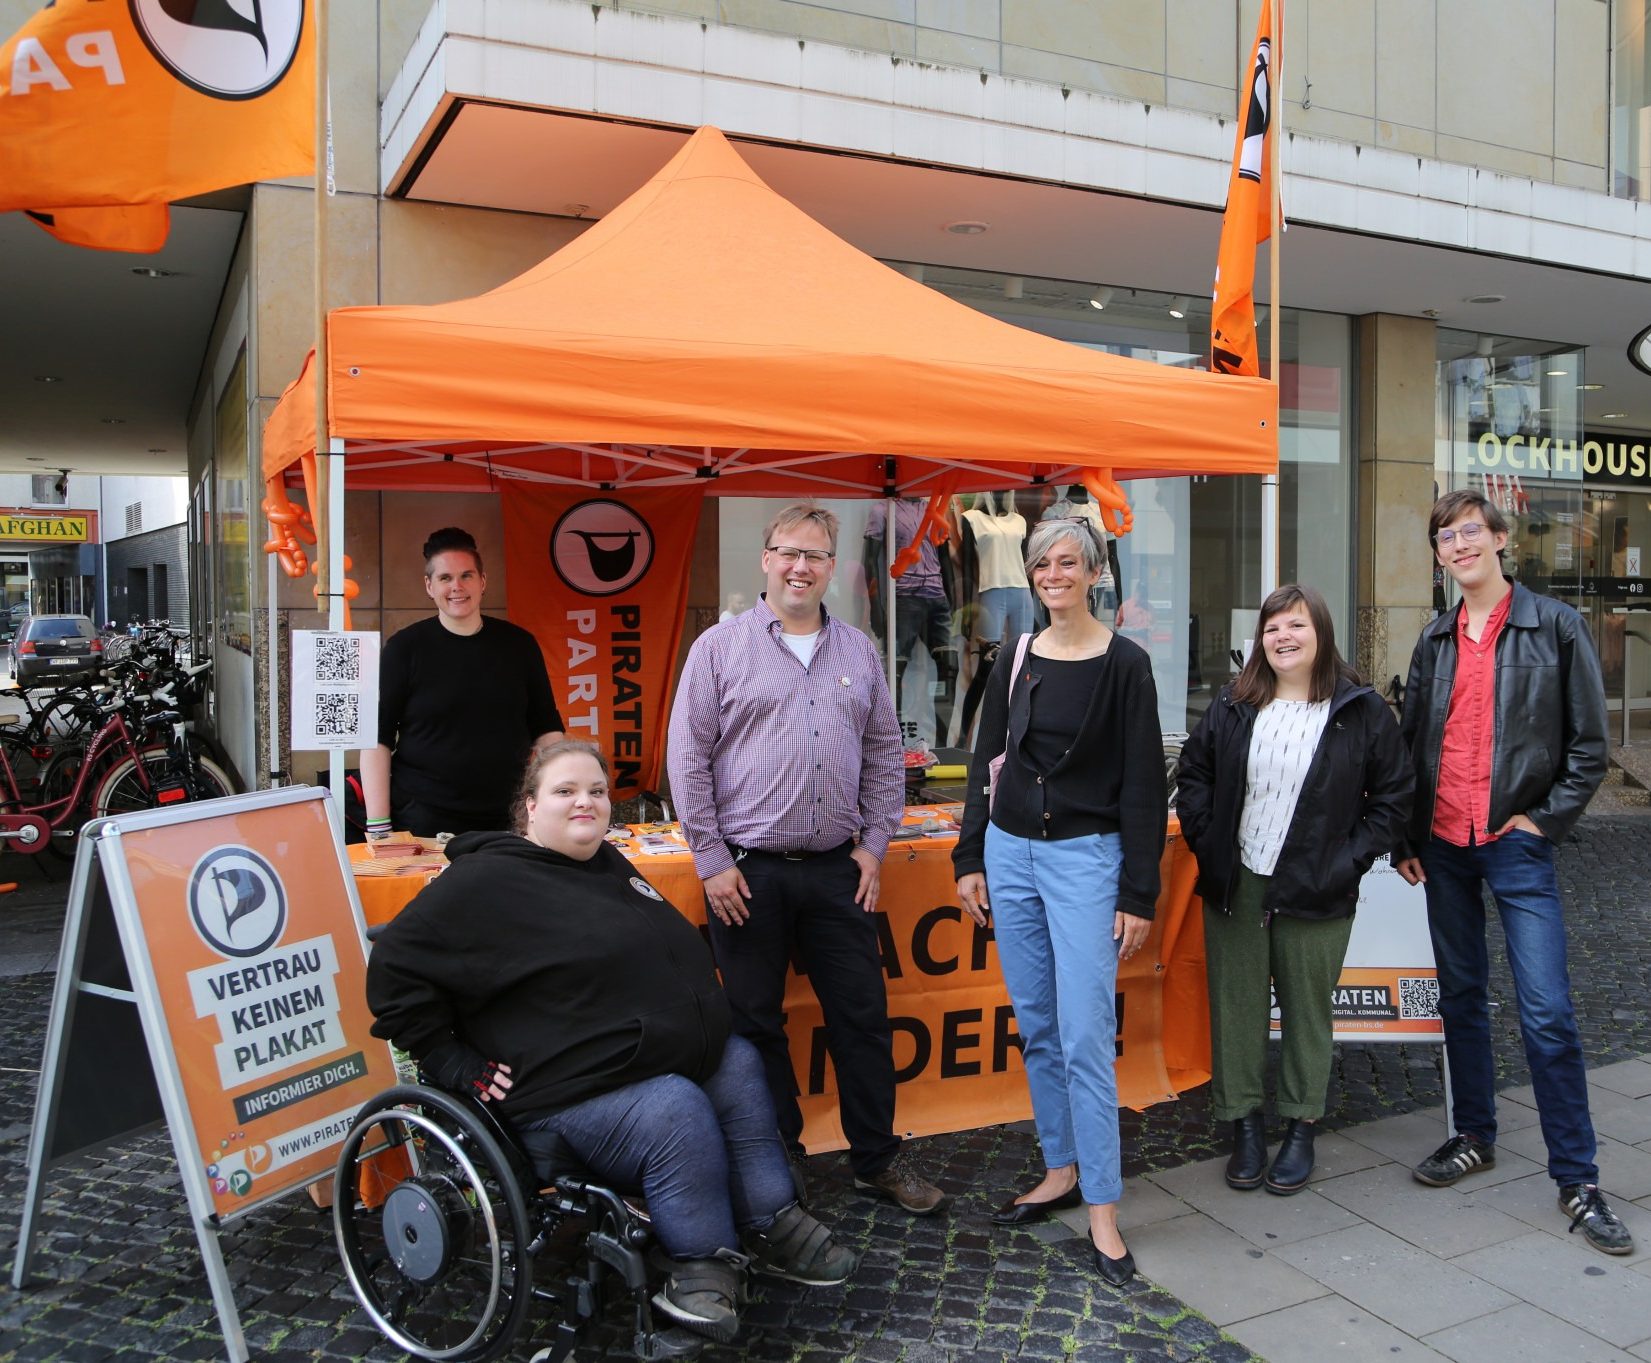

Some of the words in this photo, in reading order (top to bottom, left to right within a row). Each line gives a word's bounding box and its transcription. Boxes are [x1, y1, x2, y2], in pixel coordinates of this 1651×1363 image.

[1467, 431, 1651, 478] OCKHOUS
[566, 609, 600, 742] PART
[610, 605, 643, 789] PIRATEN
[90, 728, 107, 754] CYCLING
[208, 949, 321, 1001] VERTRAU
[1331, 989, 1387, 1005] RATEN
[231, 984, 325, 1034] KEINEM
[1333, 1021, 1384, 1029] piraten-bs.de
[234, 1019, 326, 1073] PLAKAT
[245, 1075, 323, 1116] INFORMIER
[324, 1061, 360, 1085] DICH.
[278, 1115, 357, 1158] WWW.PIRATE
